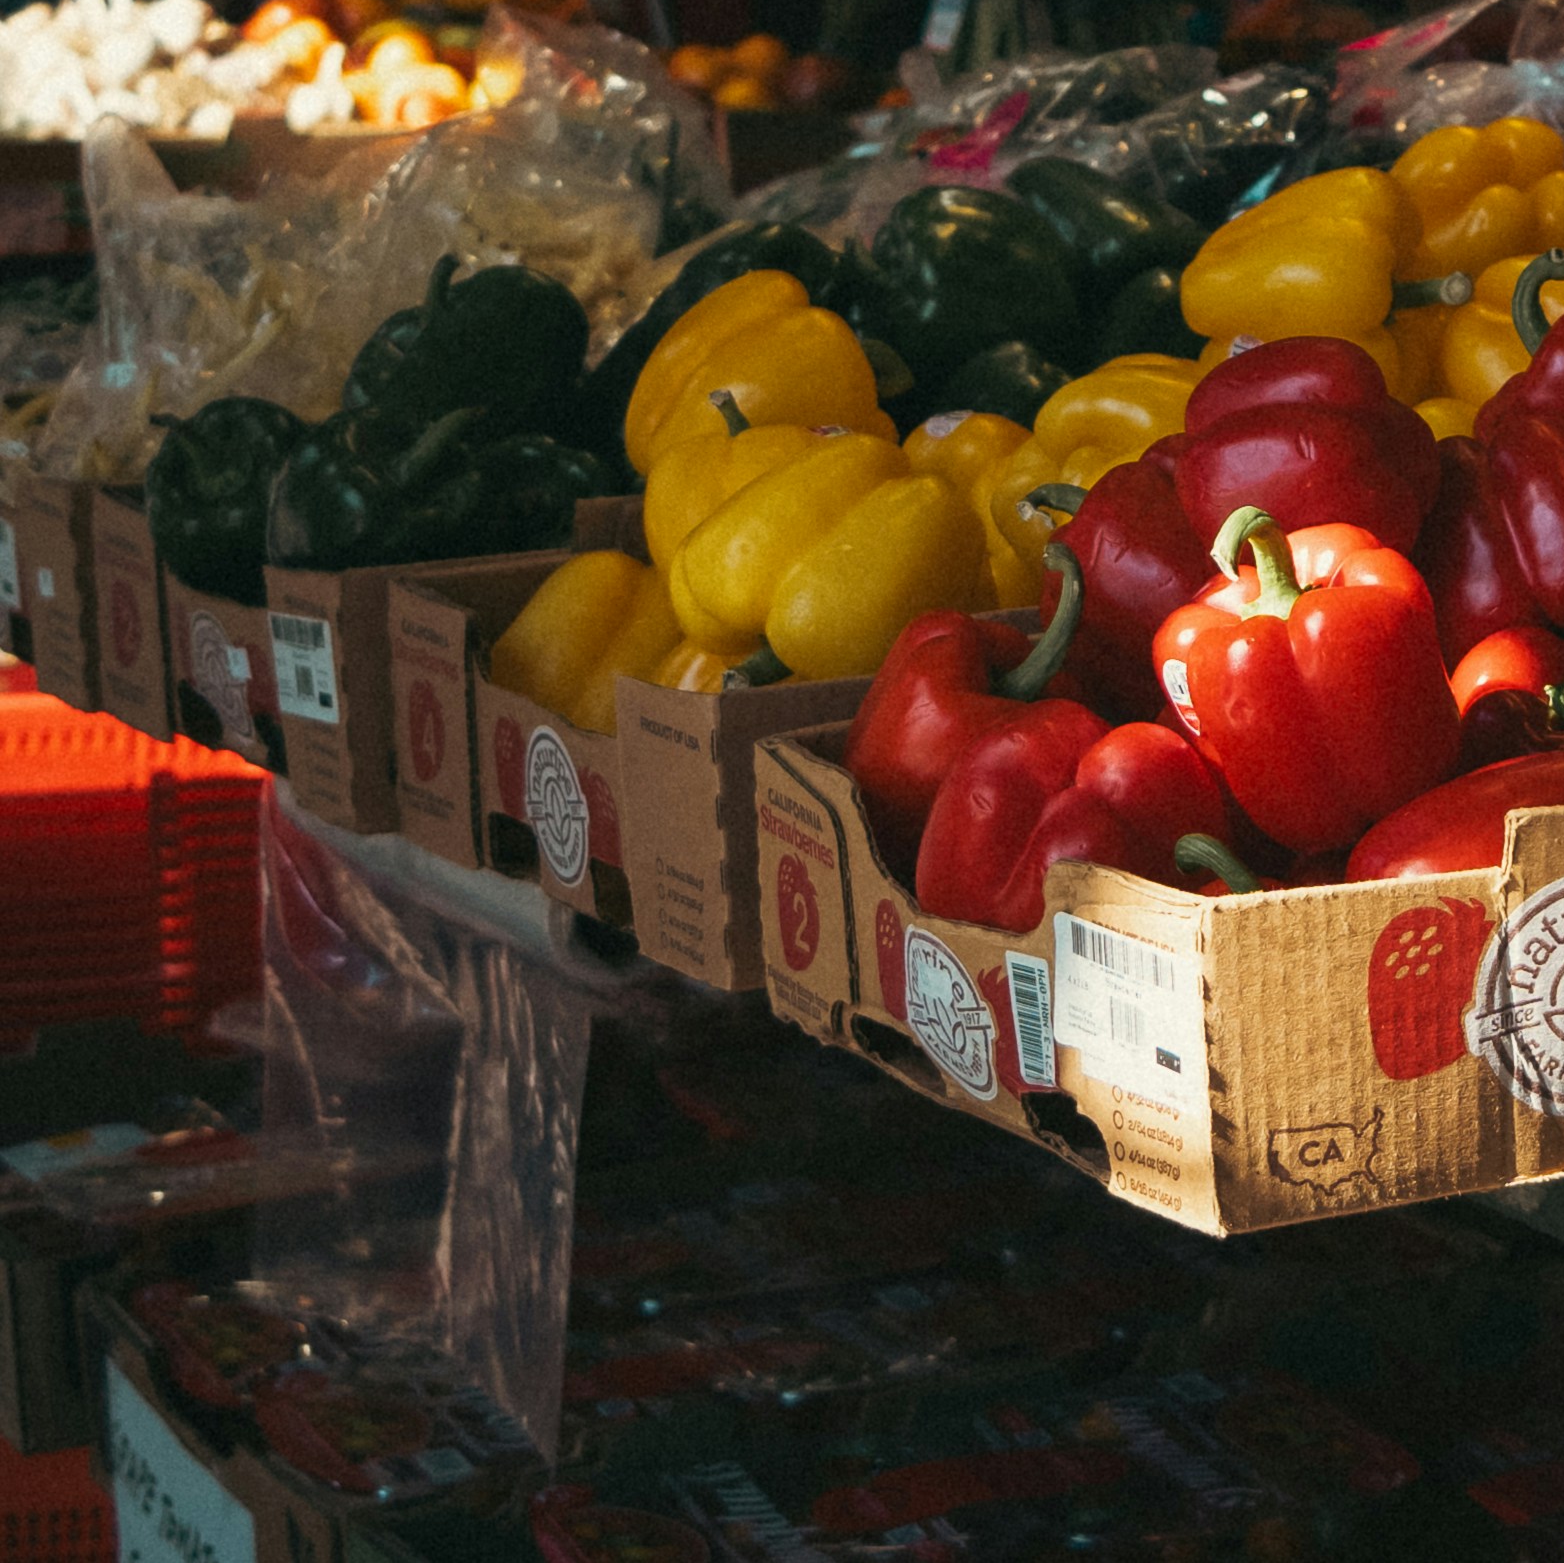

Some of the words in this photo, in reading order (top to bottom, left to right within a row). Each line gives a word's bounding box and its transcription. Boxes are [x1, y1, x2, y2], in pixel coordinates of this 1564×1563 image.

[768, 787, 823, 832] CALIFORNIA
[760, 804, 835, 870] Strawberries
[793, 891, 811, 953] 2
[963, 1011, 981, 1026] 1917
[1491, 1003, 1536, 1034] since
[1300, 1139, 1346, 1170] CA
